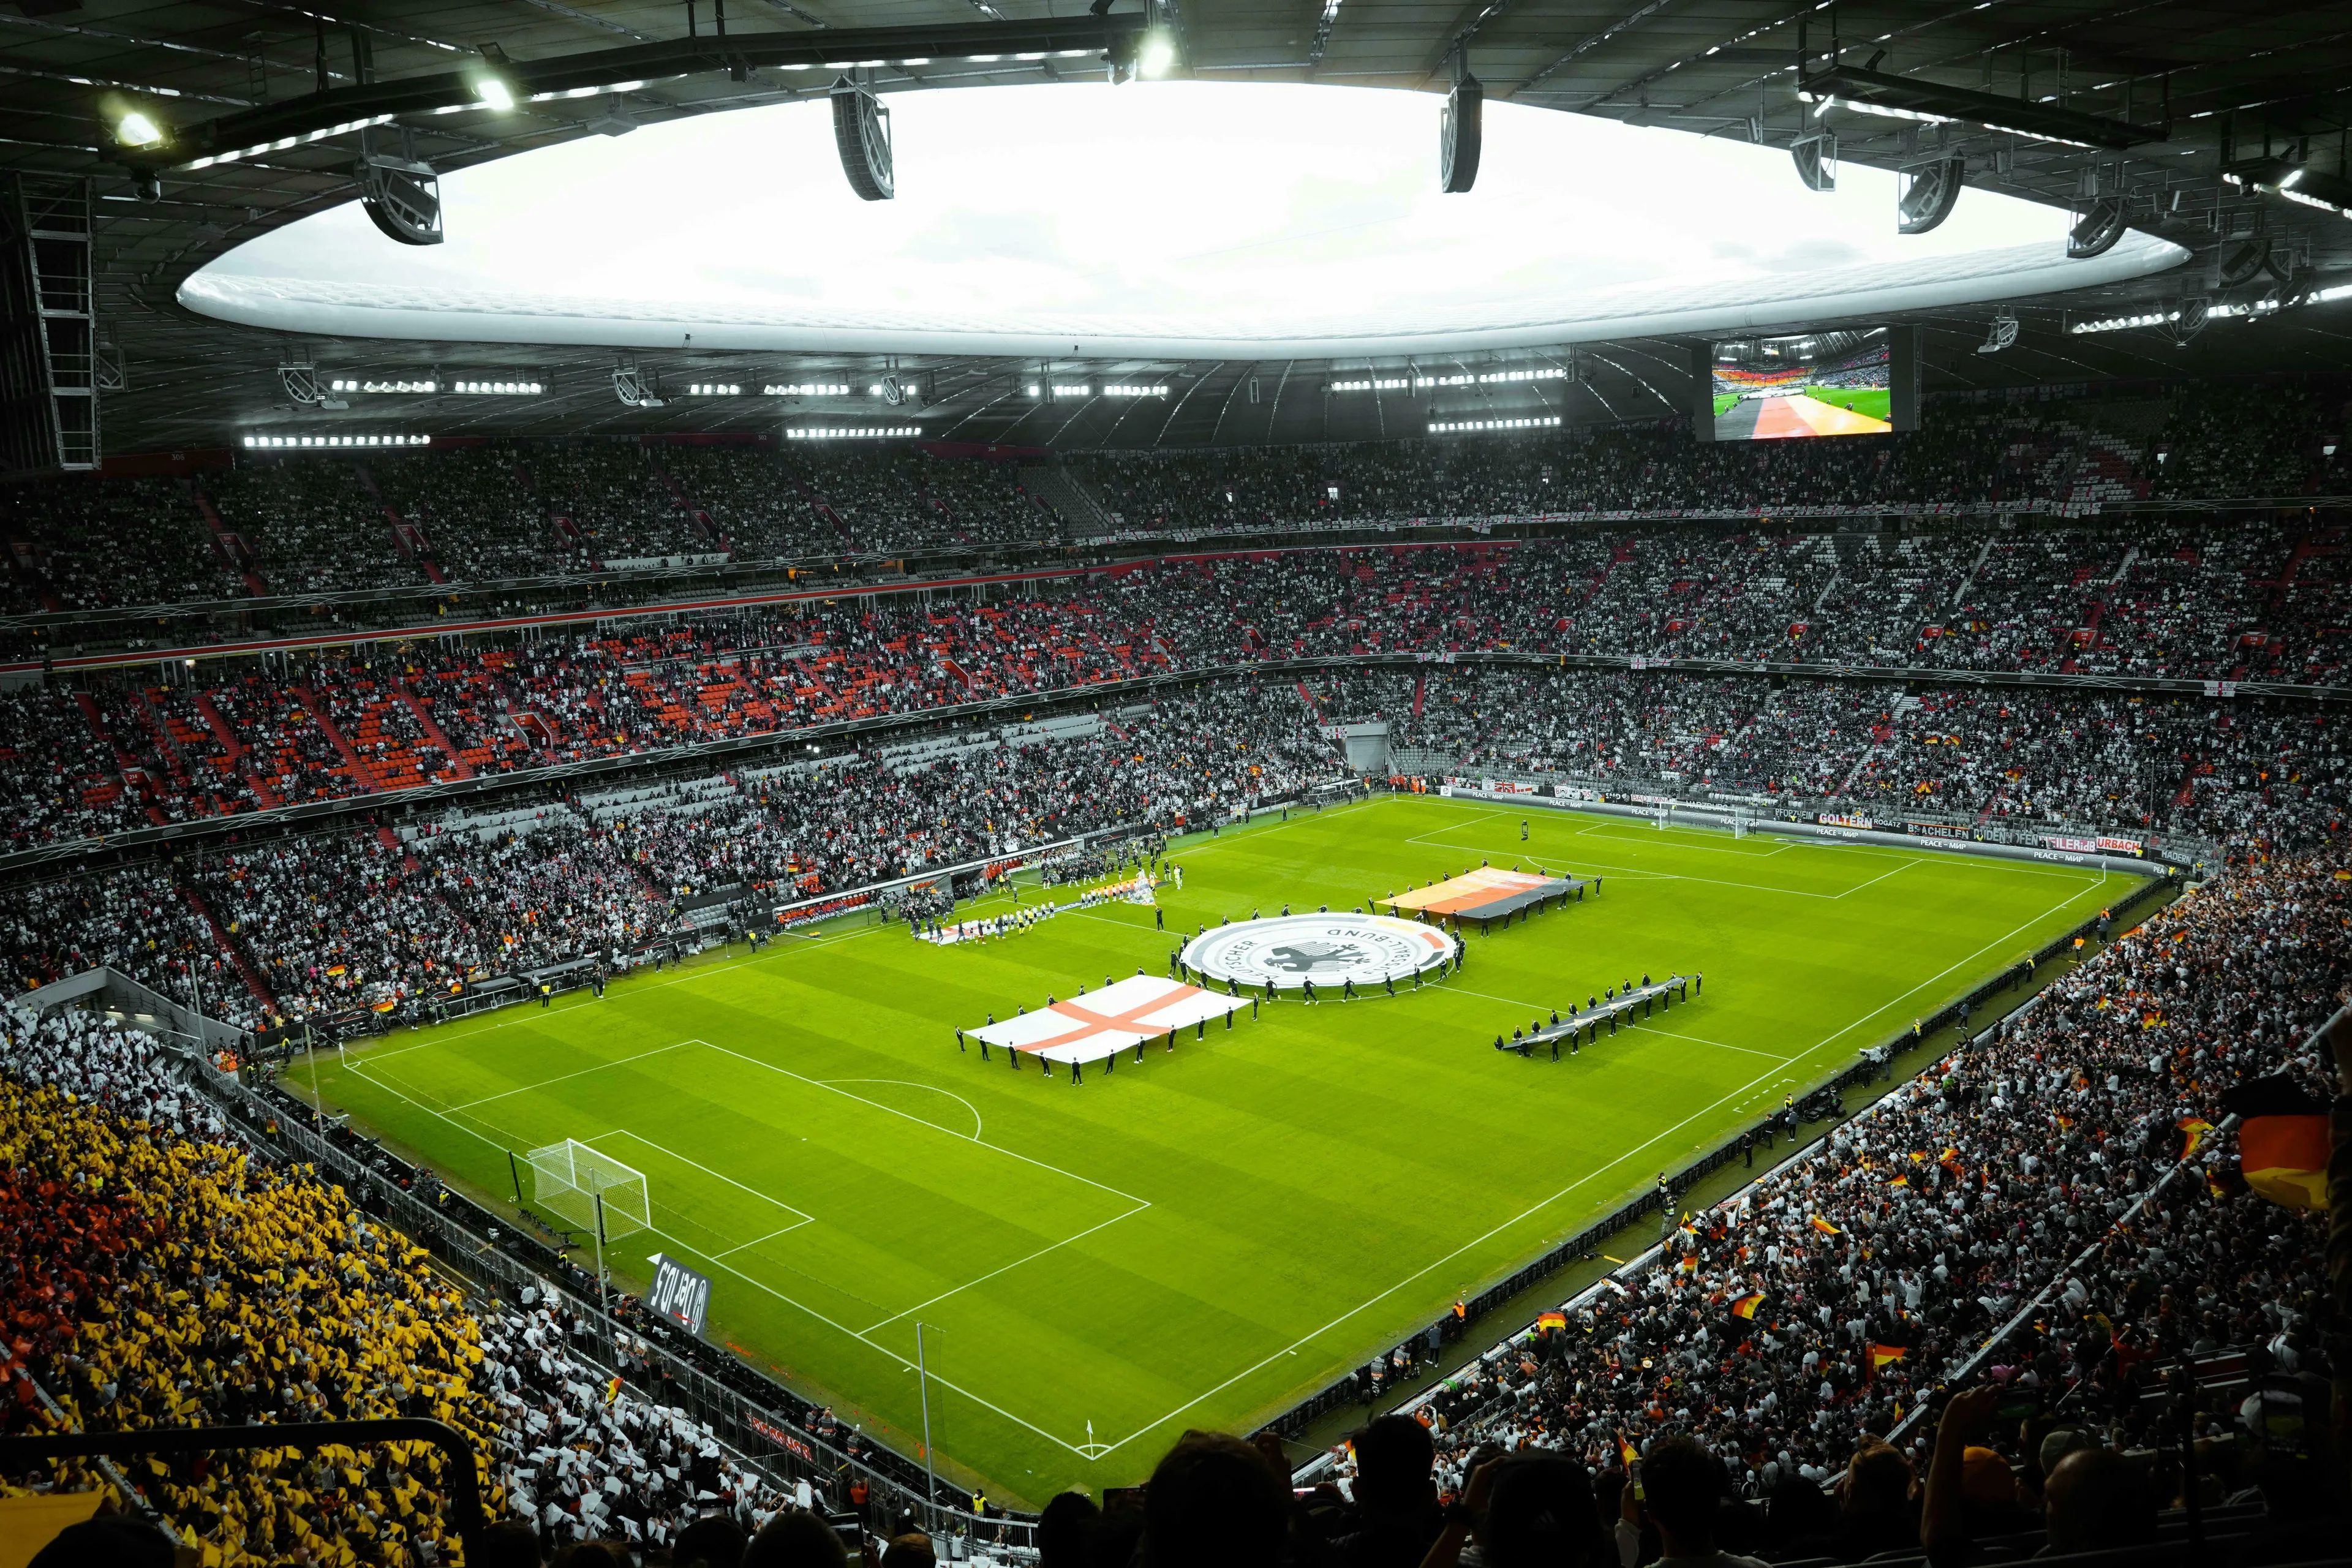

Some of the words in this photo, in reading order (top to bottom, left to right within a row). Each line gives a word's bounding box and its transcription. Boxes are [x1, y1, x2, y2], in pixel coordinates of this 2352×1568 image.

[1819, 813, 1872, 829] GOLTERN
[1920, 839, 1943, 847] PEACE
[2097, 838, 2140, 851] URBACH
[2161, 850, 2192, 864] HADERN
[1225, 940, 1279, 979] DEUTSCHER
[1327, 929, 1411, 974] FUSSBALL-BUND
[650, 1261, 680, 1314] ID.5
[673, 1272, 697, 1325] Der
[1732, 1482, 1741, 1493] 27
